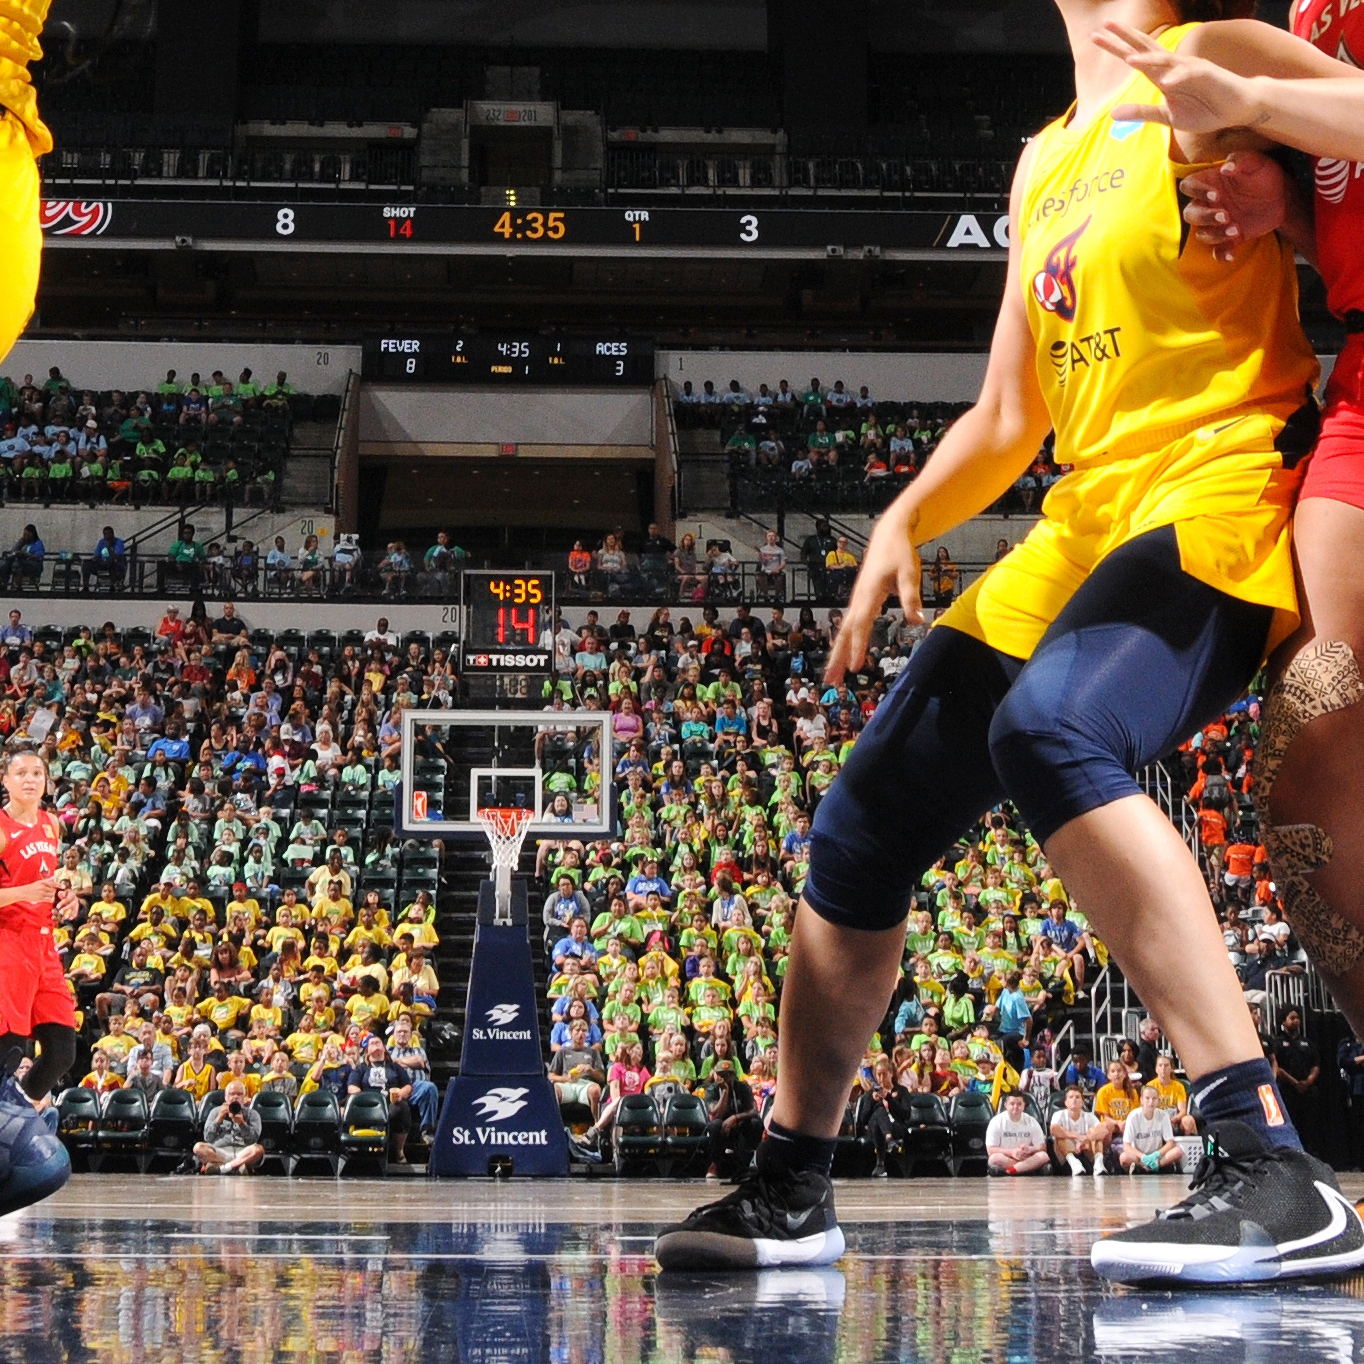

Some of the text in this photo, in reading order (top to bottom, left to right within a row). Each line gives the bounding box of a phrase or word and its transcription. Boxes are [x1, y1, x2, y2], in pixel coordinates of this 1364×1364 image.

[1310, 3, 1332, 42] AS
[382, 206, 416, 218] SHOT
[624, 211, 650, 222] QTR
[276, 208, 295, 236] 8
[387, 219, 414, 238] 14
[494, 211, 566, 240] 4:35
[740, 215, 760, 242] 3
[632, 223, 640, 242] 1
[380, 340, 420, 353] FEVER
[497, 342, 530, 358] 4:35
[596, 342, 628, 356] ACES
[1070, 327, 1122, 372] AT&T
[316, 350, 330, 366] 20
[406, 358, 416, 374] 8
[614, 360, 624, 376] 3
[300, 520, 314, 536] 20
[490, 579, 542, 604] 4:35
[442, 606, 456, 623] 20
[497, 608, 535, 644] 14
[489, 654, 548, 667] TISSOT
